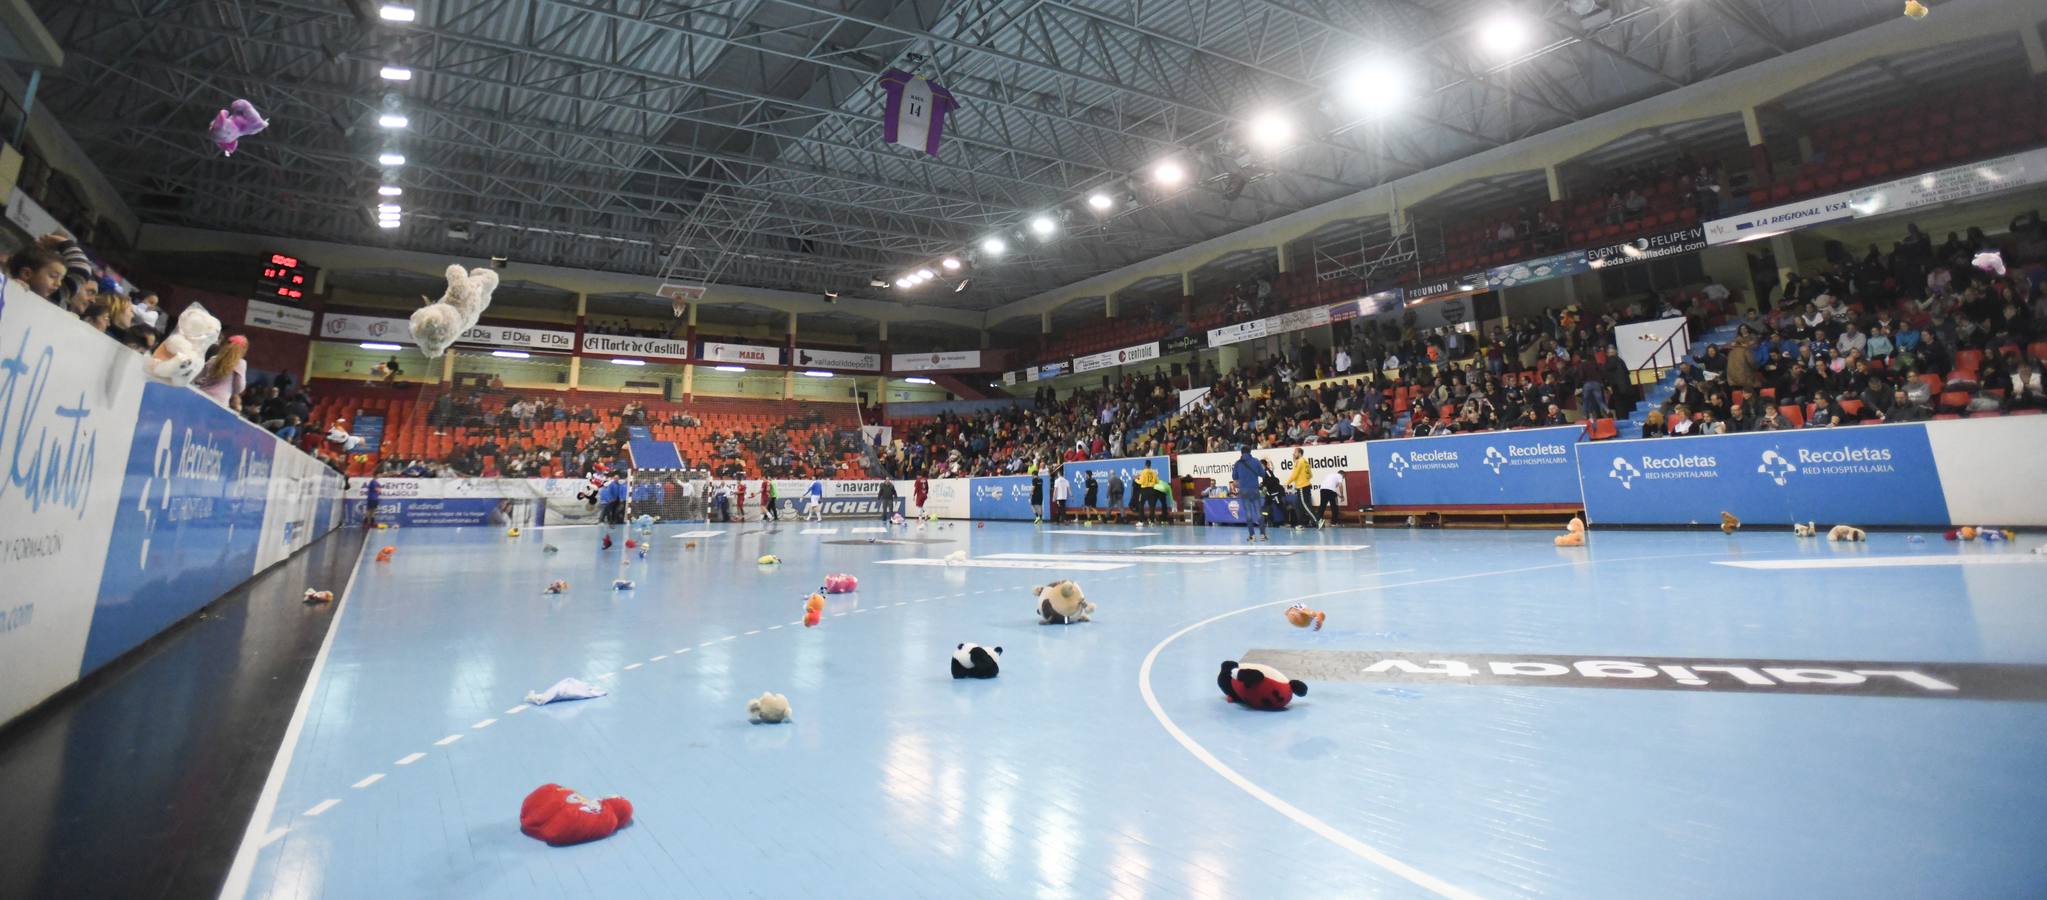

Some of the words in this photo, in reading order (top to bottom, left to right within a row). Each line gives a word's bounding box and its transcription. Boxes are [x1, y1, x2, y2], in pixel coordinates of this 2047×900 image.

[909, 103, 921, 117] 14
[1756, 217, 1768, 227] LA
[1771, 208, 1821, 225] REGIONAL
[502, 331, 511, 340] El
[513, 331, 531, 342] Día
[541, 333, 550, 343] El
[552, 334, 569, 345] Día
[584, 337, 598, 350] El
[601, 338, 631, 352] Norte
[631, 340, 643, 352] de
[644, 341, 685, 355] Castilla
[739, 351, 765, 360] MARCA
[1410, 450, 1458, 462] Recoletas
[1508, 443, 1566, 457] Recoletas
[1797, 446, 1892, 463] Recoletas
[1280, 459, 1294, 471] de
[1523, 457, 1568, 465] HOSPITALARIA
[1642, 454, 1717, 469] Recoletas
[1661, 470, 1718, 479] HOSPITALARIA
[1802, 466, 1821, 475] RED
[1822, 464, 1895, 475] HOSPITALARIA
[843, 482, 881, 493] navarr
